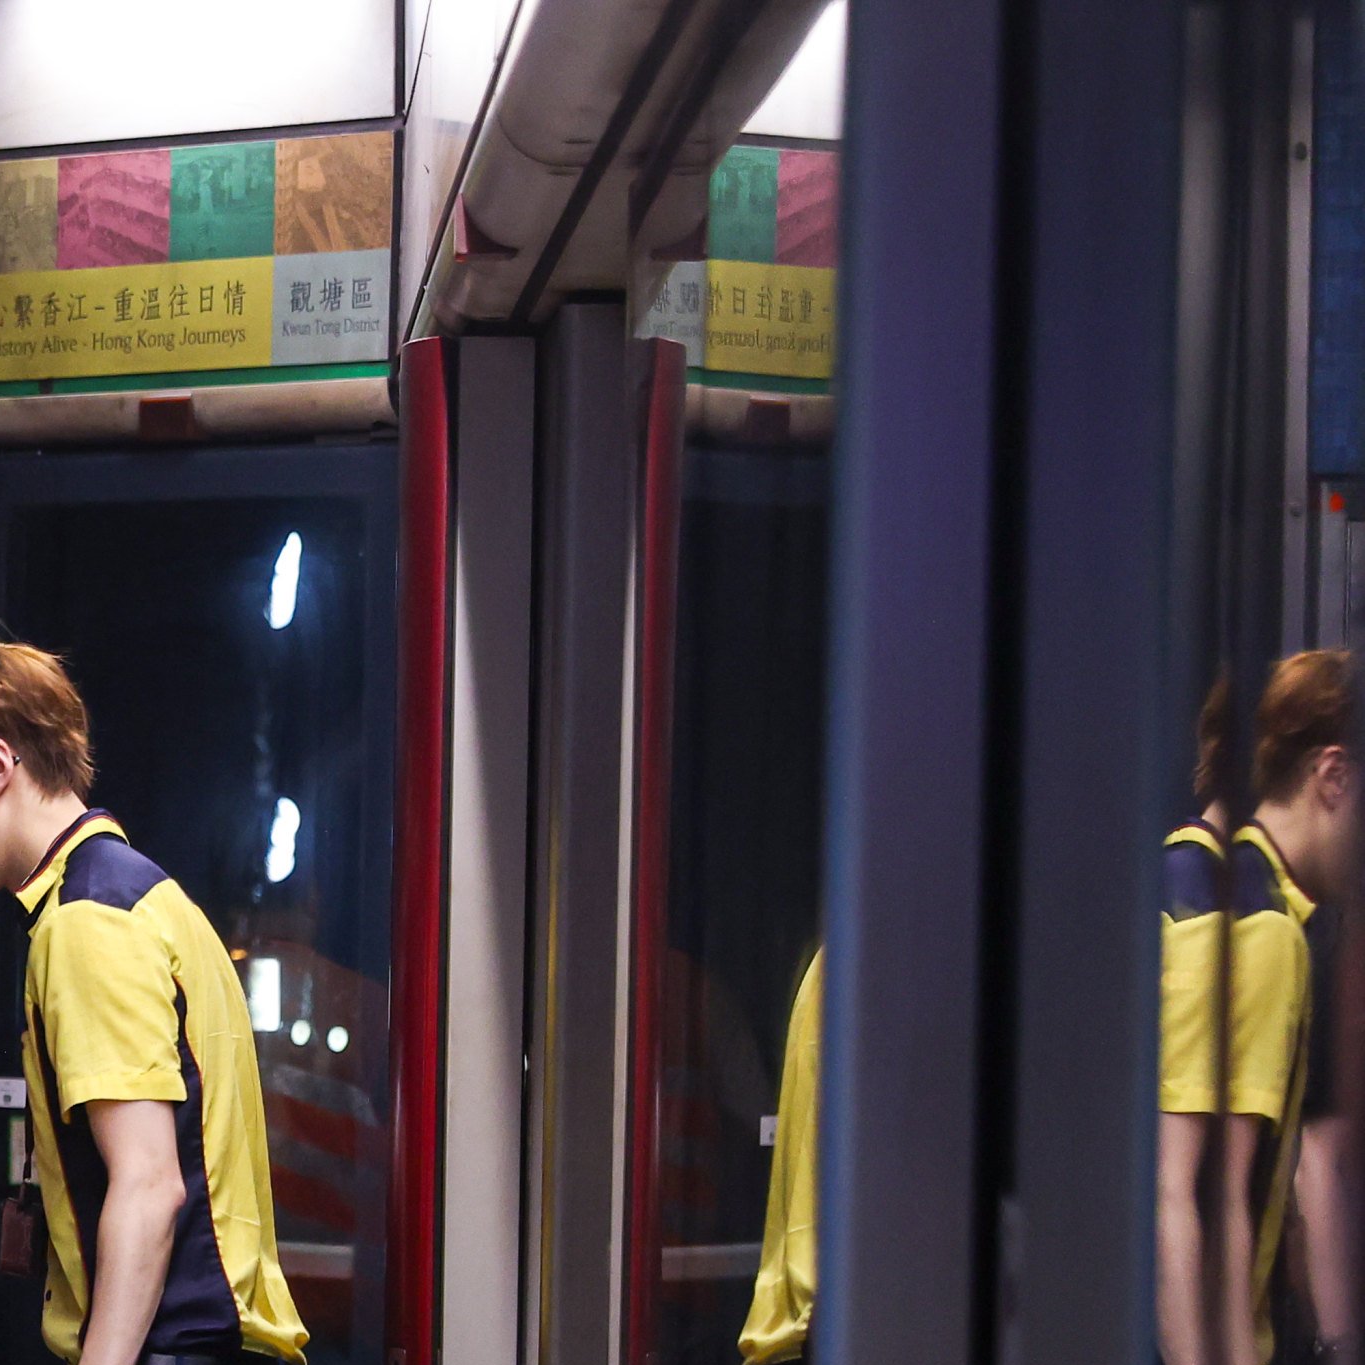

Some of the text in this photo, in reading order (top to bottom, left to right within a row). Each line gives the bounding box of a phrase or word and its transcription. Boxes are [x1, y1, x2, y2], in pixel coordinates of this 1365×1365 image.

[290, 278, 372, 313] 觀塘區
[41, 336, 78, 353] Alive
[92, 332, 132, 353] Hong
[137, 329, 174, 351] Kong
[179, 326, 246, 348] Journeys
[316, 319, 341, 338] Tong
